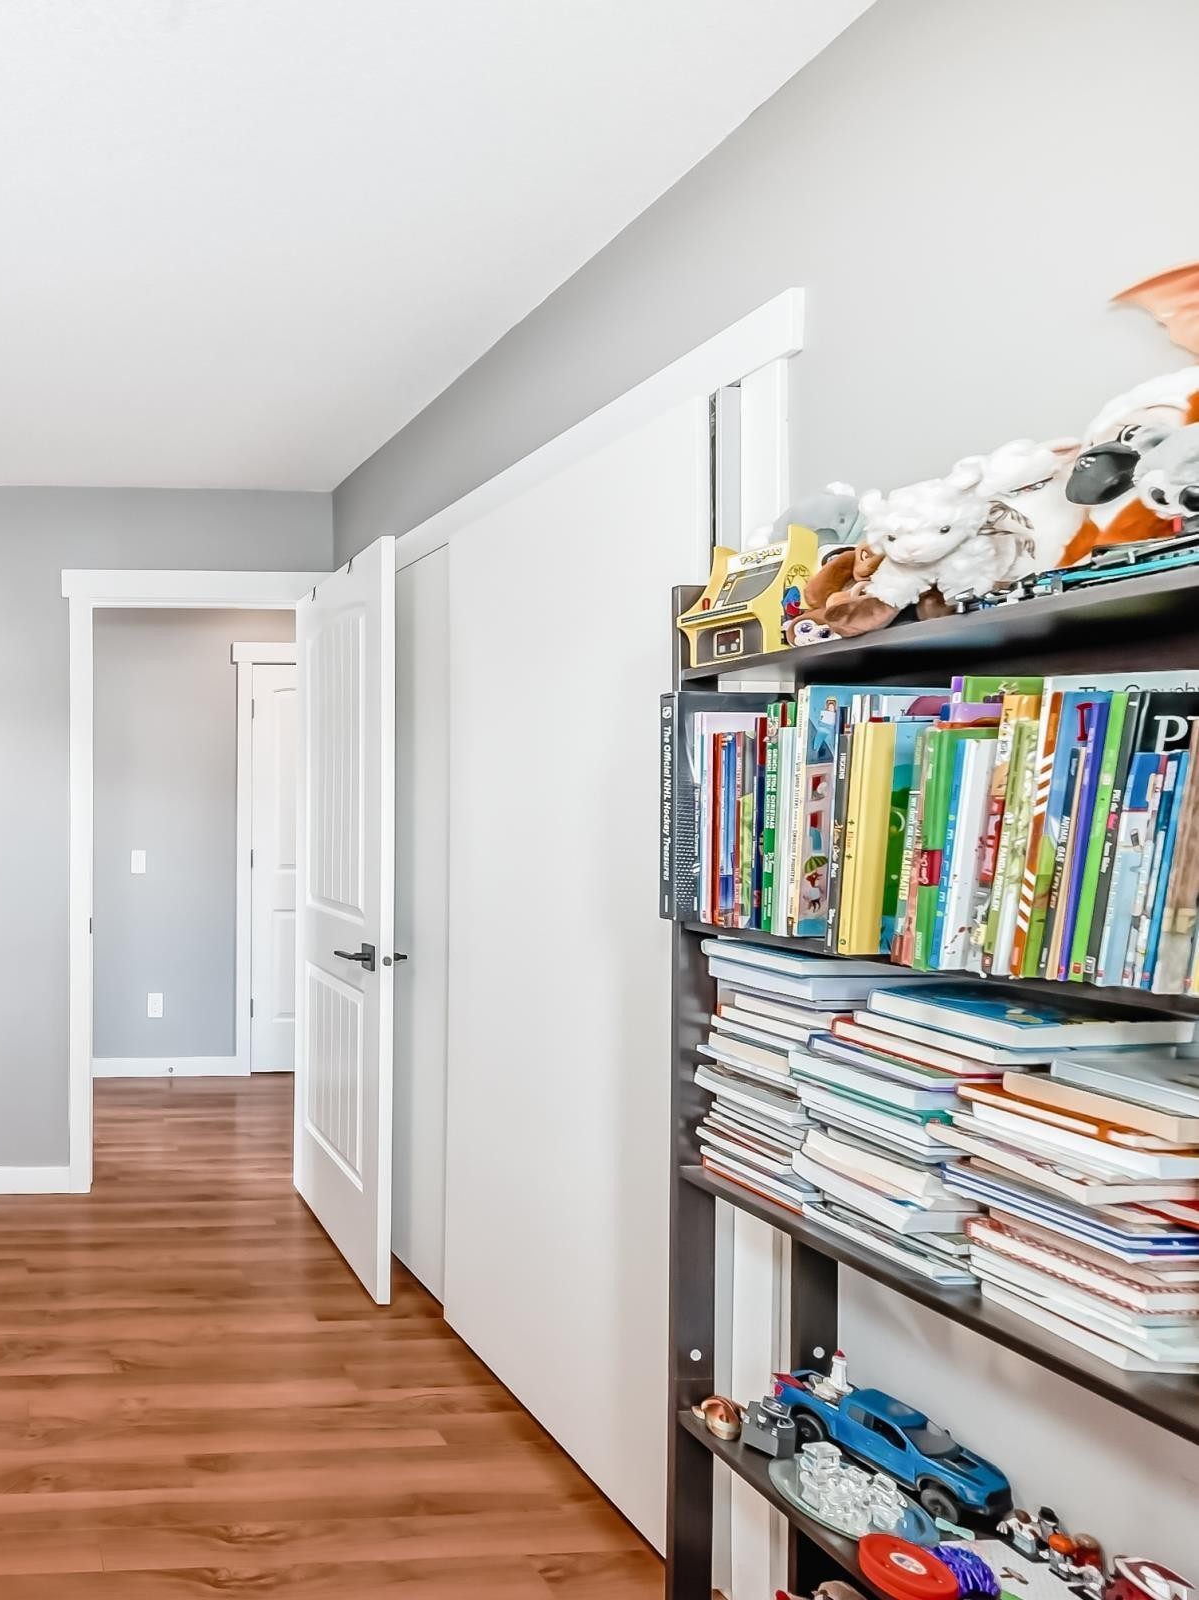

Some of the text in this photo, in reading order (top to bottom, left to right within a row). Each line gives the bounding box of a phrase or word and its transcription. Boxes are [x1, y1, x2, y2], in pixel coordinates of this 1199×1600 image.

[661, 726, 672, 881] The Official NHL Hockey Treasures
[1001, 831, 1011, 846] THE
[1057, 815, 1071, 843] ANIMAL
[997, 848, 1009, 874] PANDA
[1054, 846, 1066, 863] GAS
[899, 850, 912, 901] CLASSMATES
